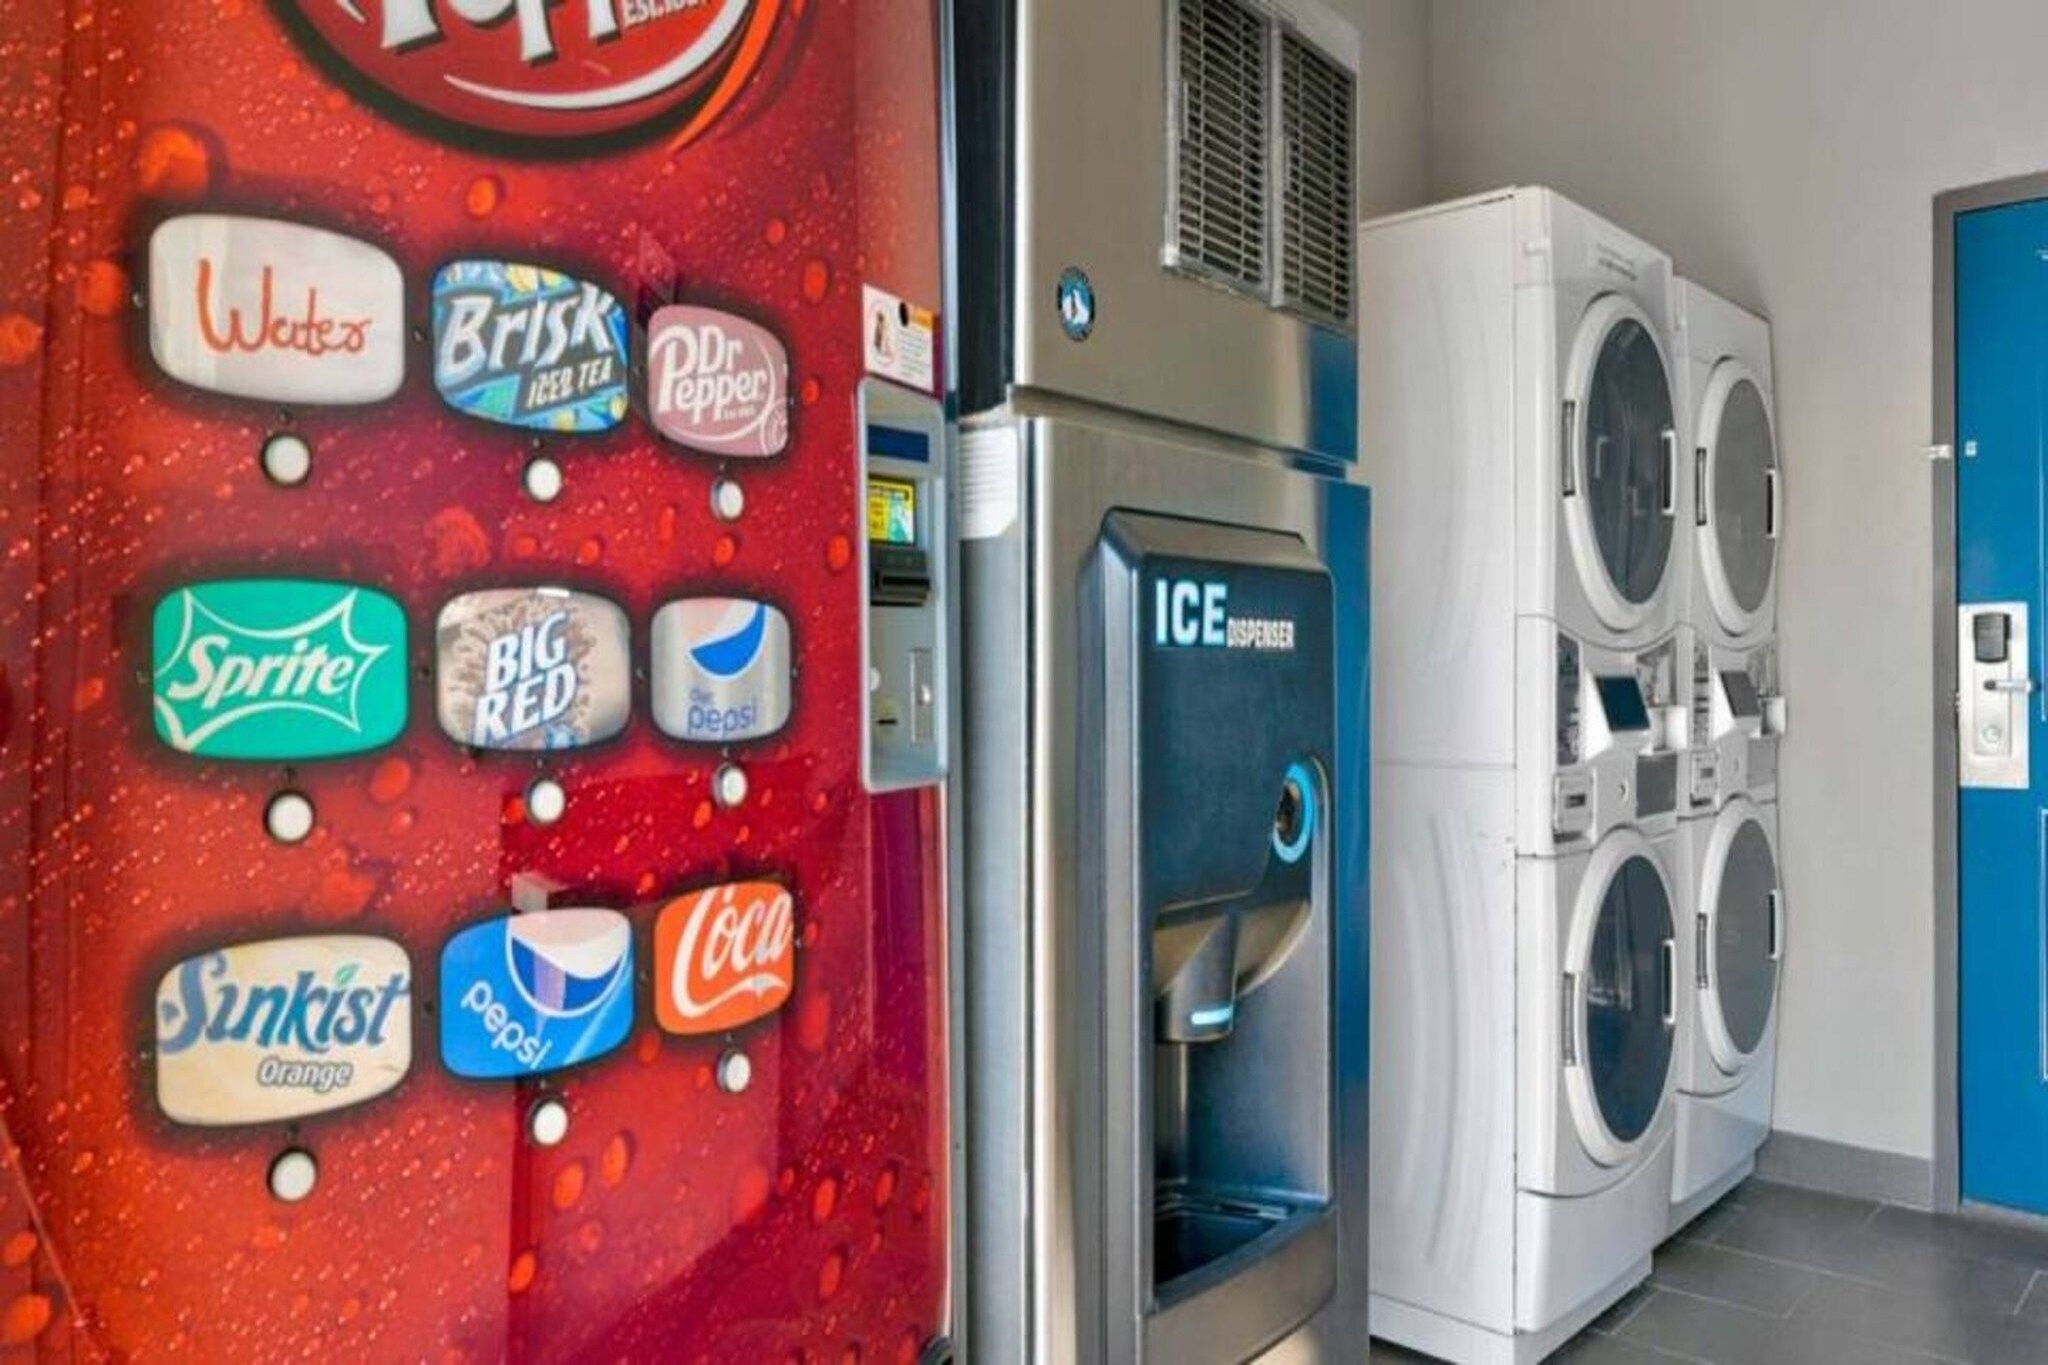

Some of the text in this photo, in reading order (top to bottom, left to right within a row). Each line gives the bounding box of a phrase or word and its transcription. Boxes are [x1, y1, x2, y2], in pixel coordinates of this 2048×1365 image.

[197, 257, 372, 357] Water
[526, 356, 613, 410] ICED TEA
[650, 325, 769, 425] Pepper
[698, 325, 744, 374] Dr
[485, 611, 567, 693] BIG
[1155, 578, 1296, 649] ICE DISPENSER
[166, 633, 354, 710] Sprite
[473, 662, 577, 747] RED
[686, 693, 758, 738] pepsi
[671, 884, 794, 1018] Coca
[158, 952, 411, 1055] Sunkist
[460, 979, 553, 1069] pepsi
[256, 1056, 354, 1094] Orange
